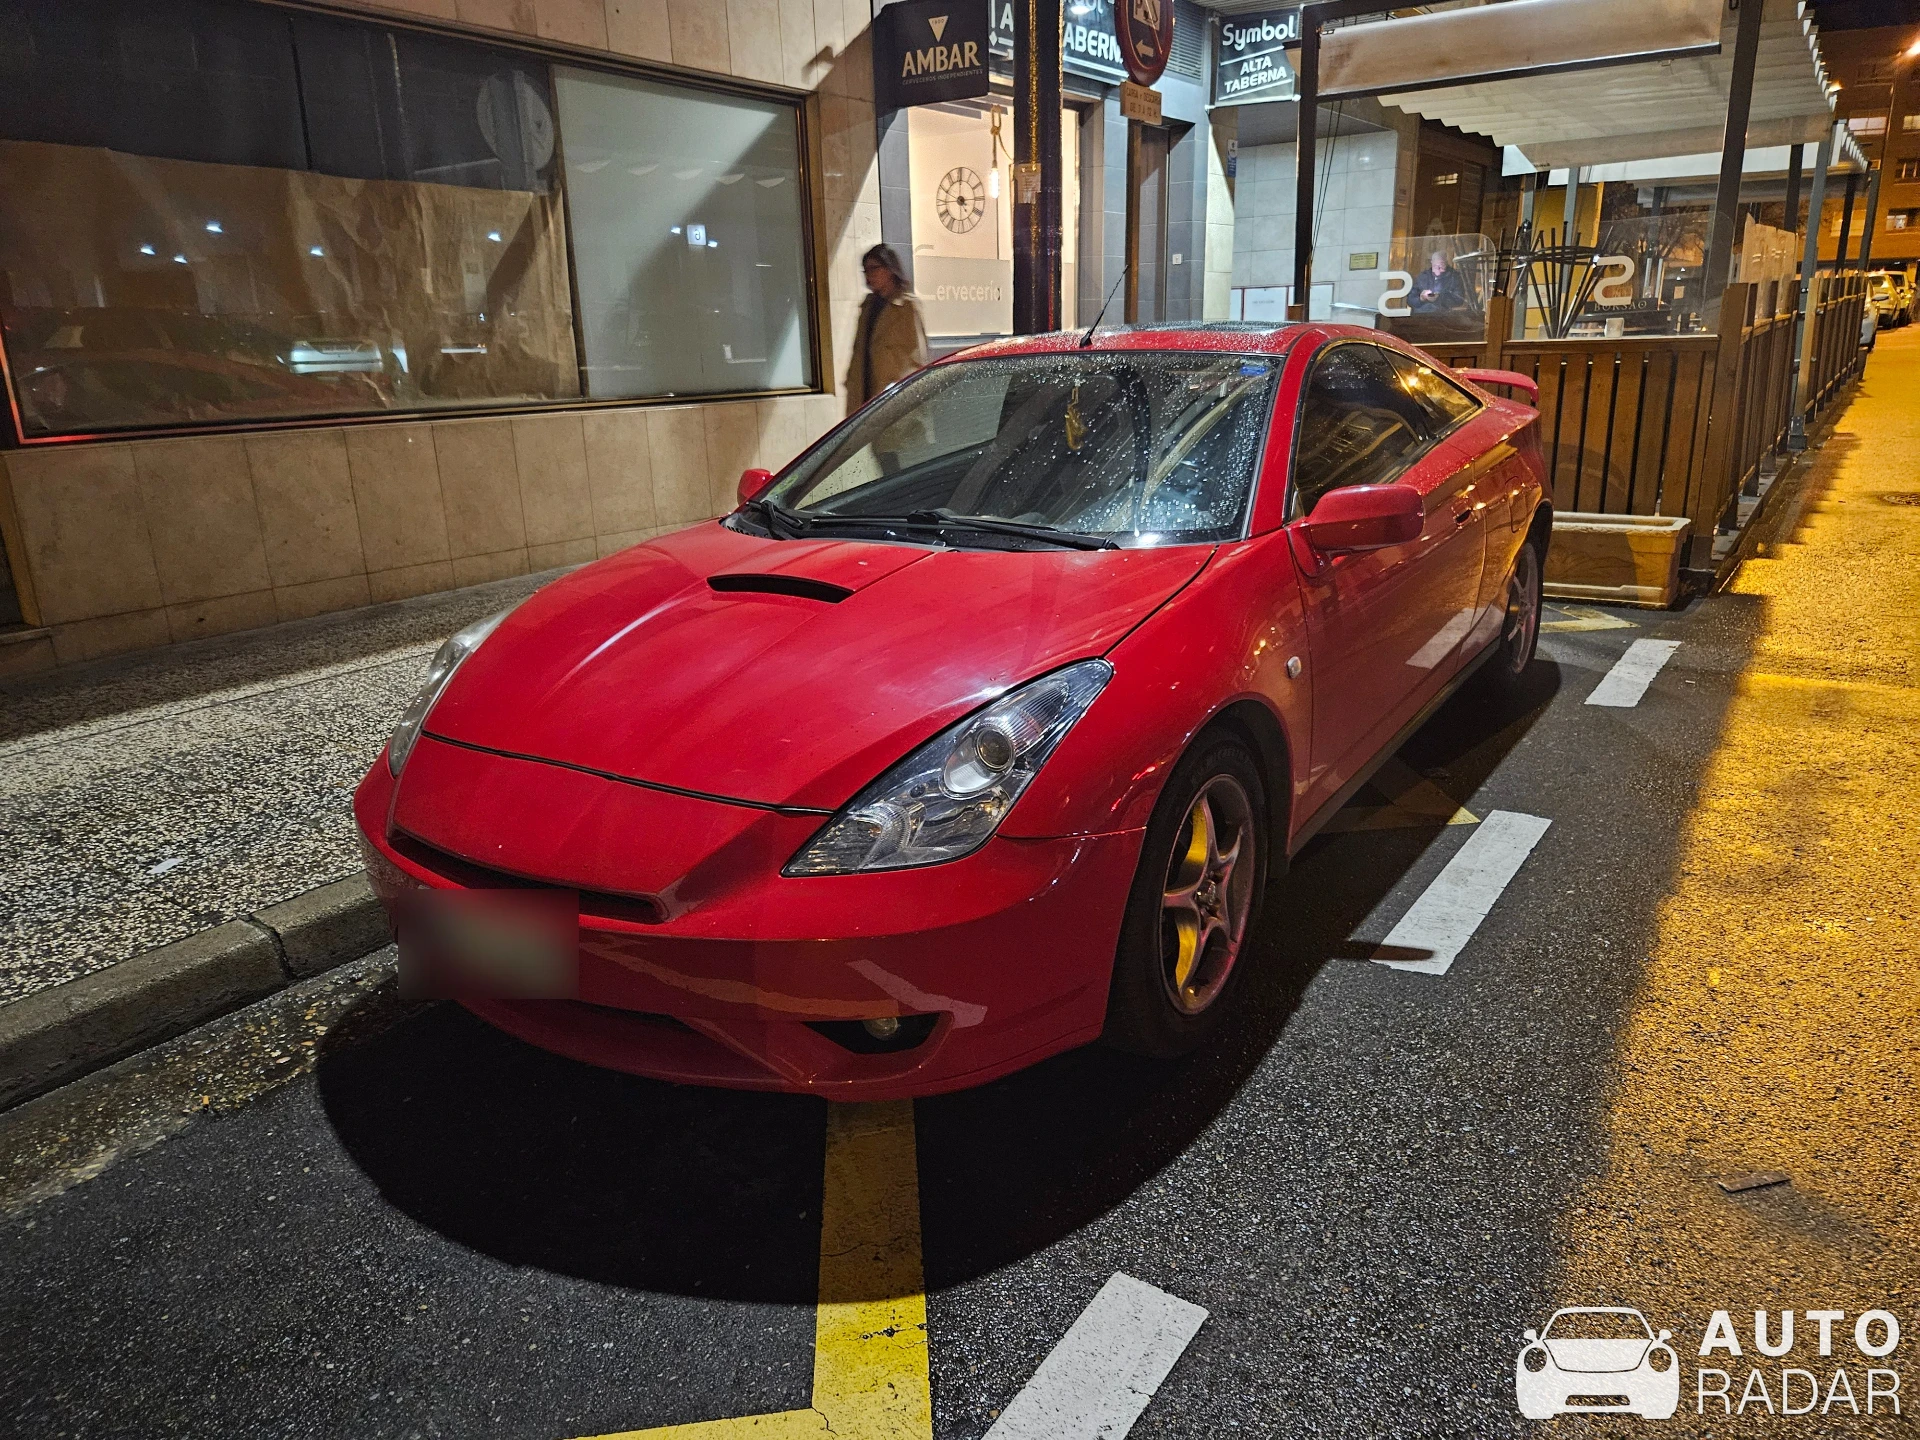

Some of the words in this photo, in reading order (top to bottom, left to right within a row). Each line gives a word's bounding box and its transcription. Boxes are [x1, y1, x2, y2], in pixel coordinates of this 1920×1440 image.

[1062, 21, 1123, 64] ABERN
[1222, 15, 1295, 51] Symbol
[902, 41, 981, 78] AMBAR
[1240, 56, 1272, 75] ALTA
[1224, 66, 1287, 93] TABERNA
